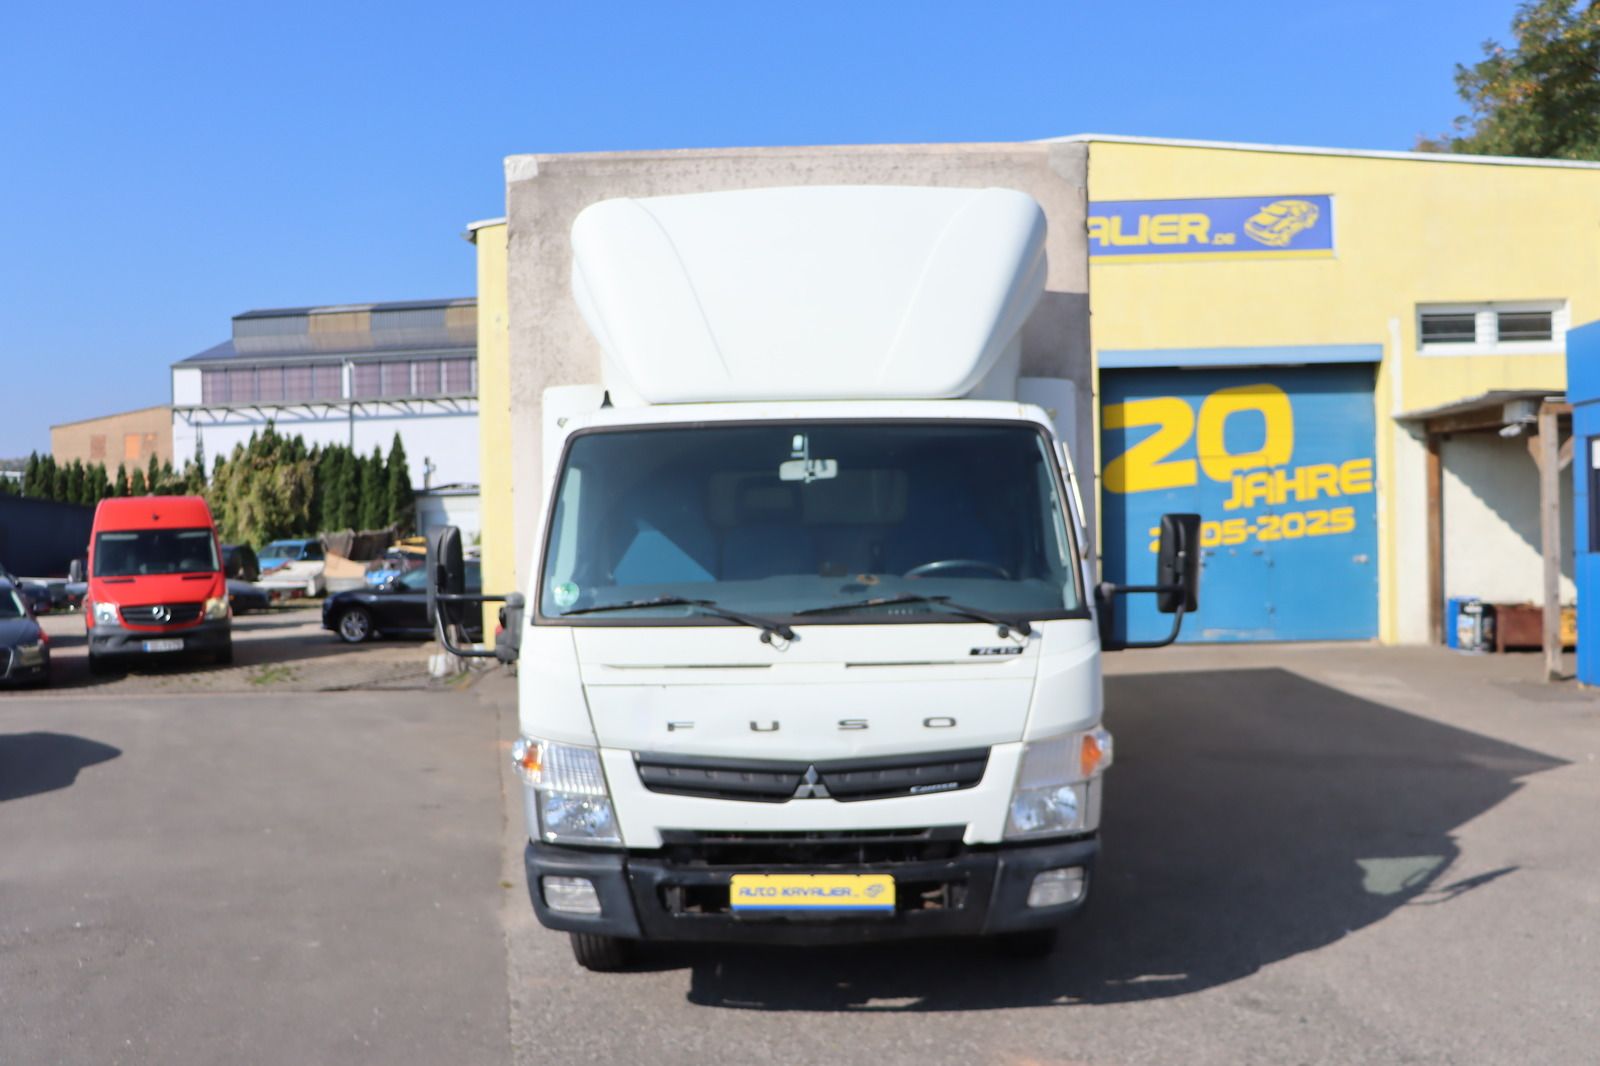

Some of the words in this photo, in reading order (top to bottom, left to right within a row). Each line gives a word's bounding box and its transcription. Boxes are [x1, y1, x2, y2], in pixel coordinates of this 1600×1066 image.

[1102, 384, 1294, 494] 20
[1223, 458, 1373, 511] JAHRE
[1149, 507, 1356, 553] 05-2025
[667, 717, 957, 731] FUSO
[739, 886, 777, 897] AUTO
